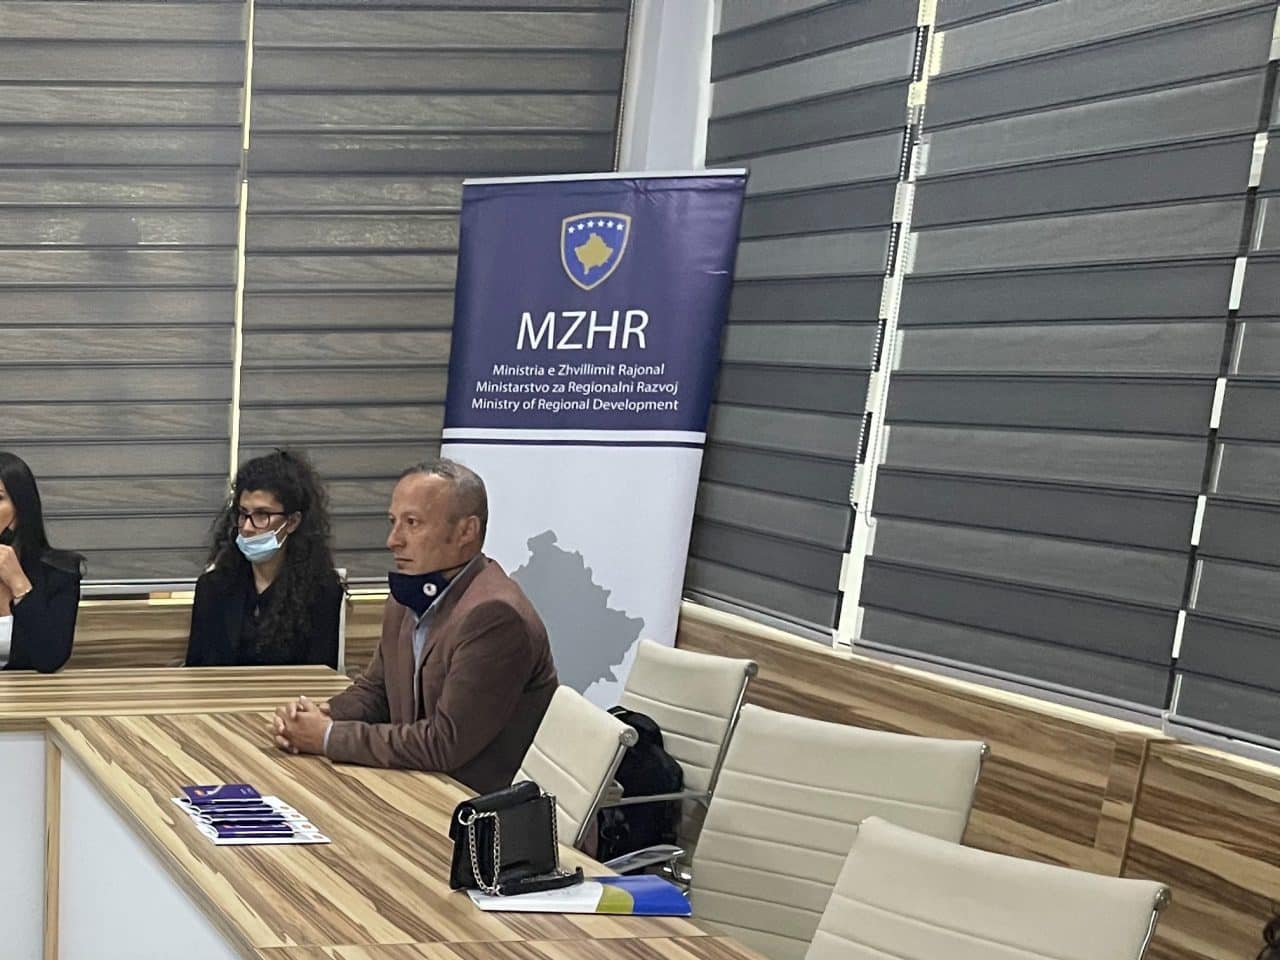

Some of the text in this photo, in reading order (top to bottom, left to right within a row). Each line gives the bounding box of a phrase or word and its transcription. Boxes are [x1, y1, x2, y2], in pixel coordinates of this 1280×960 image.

[516, 310, 649, 350] MZHR
[493, 363, 665, 379] Ministria e Zhvillimit Rajonal
[476, 381, 679, 396] Ministarstvo za Regionalni Razvoj
[471, 398, 679, 413] Ministry of Regional Development
